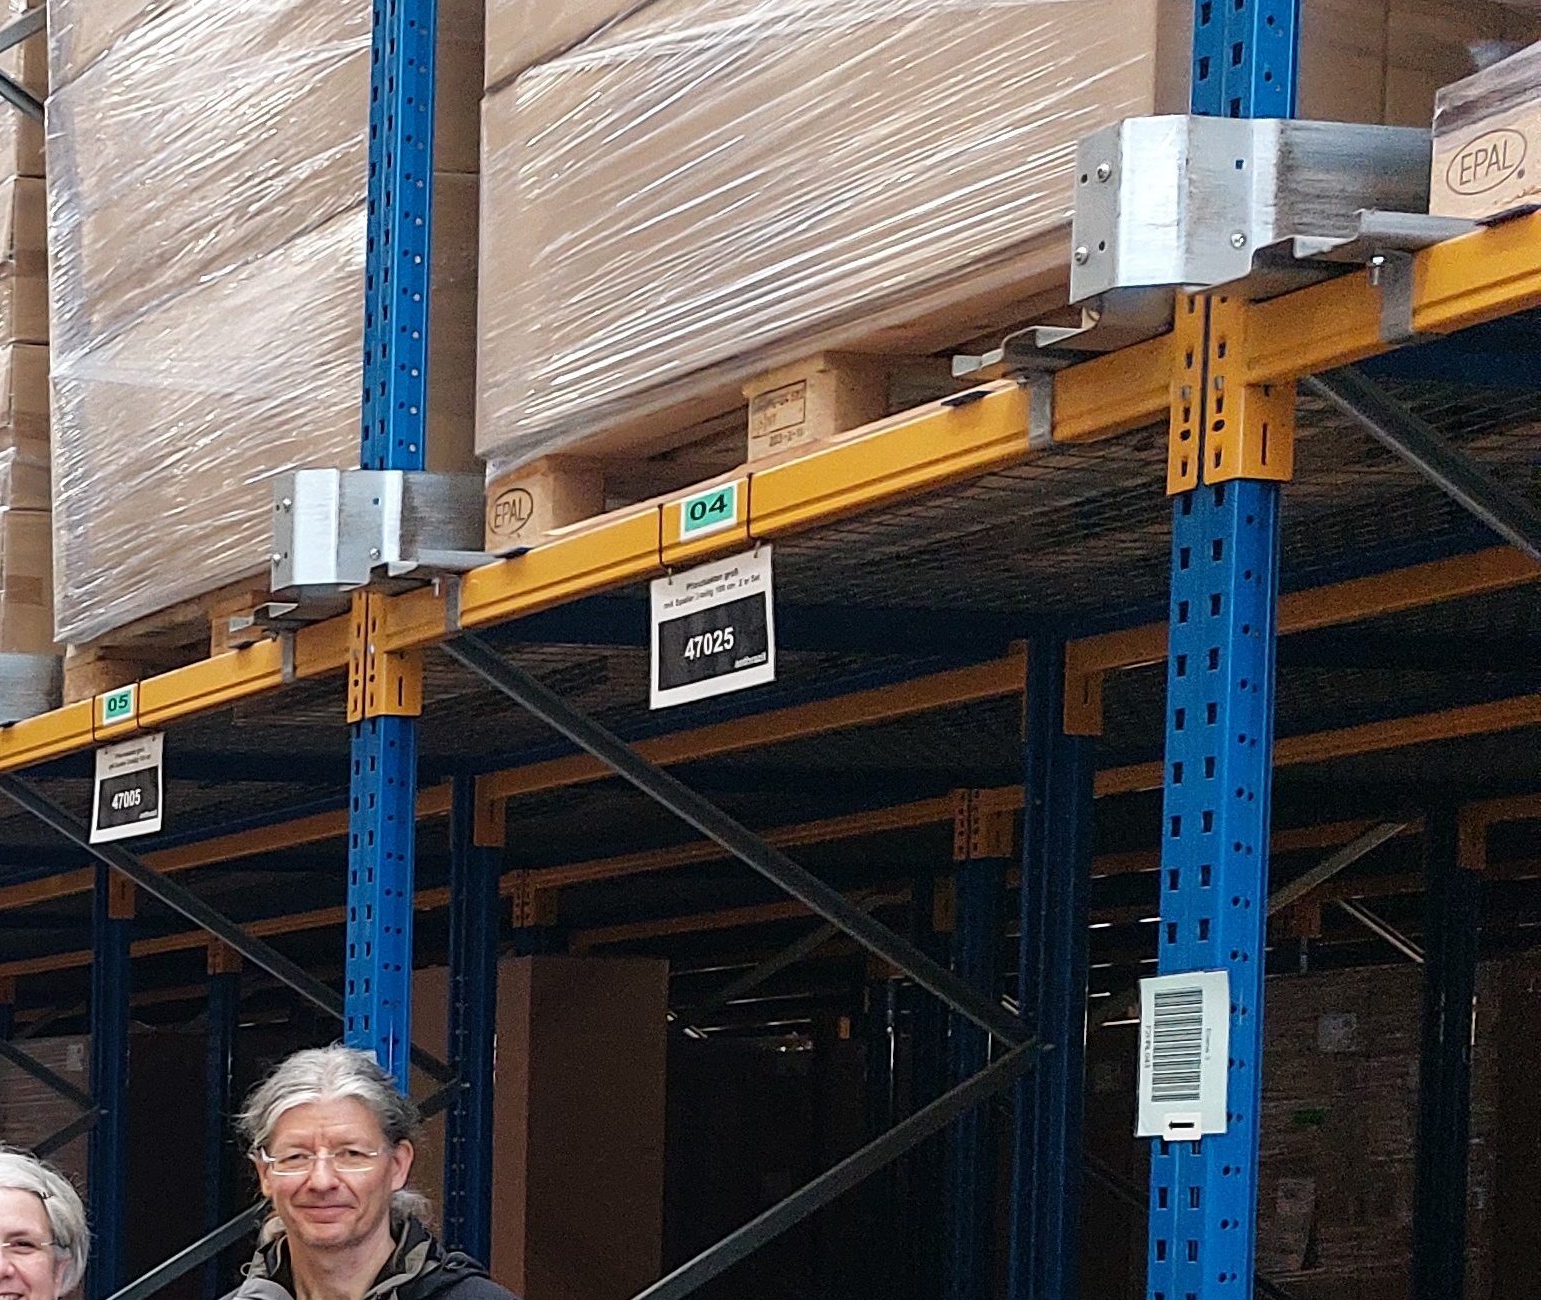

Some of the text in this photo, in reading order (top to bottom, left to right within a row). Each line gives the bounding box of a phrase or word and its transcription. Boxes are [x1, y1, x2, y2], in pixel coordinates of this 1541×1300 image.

[1459, 139, 1515, 187] EPAL
[494, 496, 526, 529] EPAL
[690, 494, 729, 521] 04
[684, 626, 735, 661] 47025
[107, 693, 129, 712] 05
[111, 788, 142, 810] 47005
